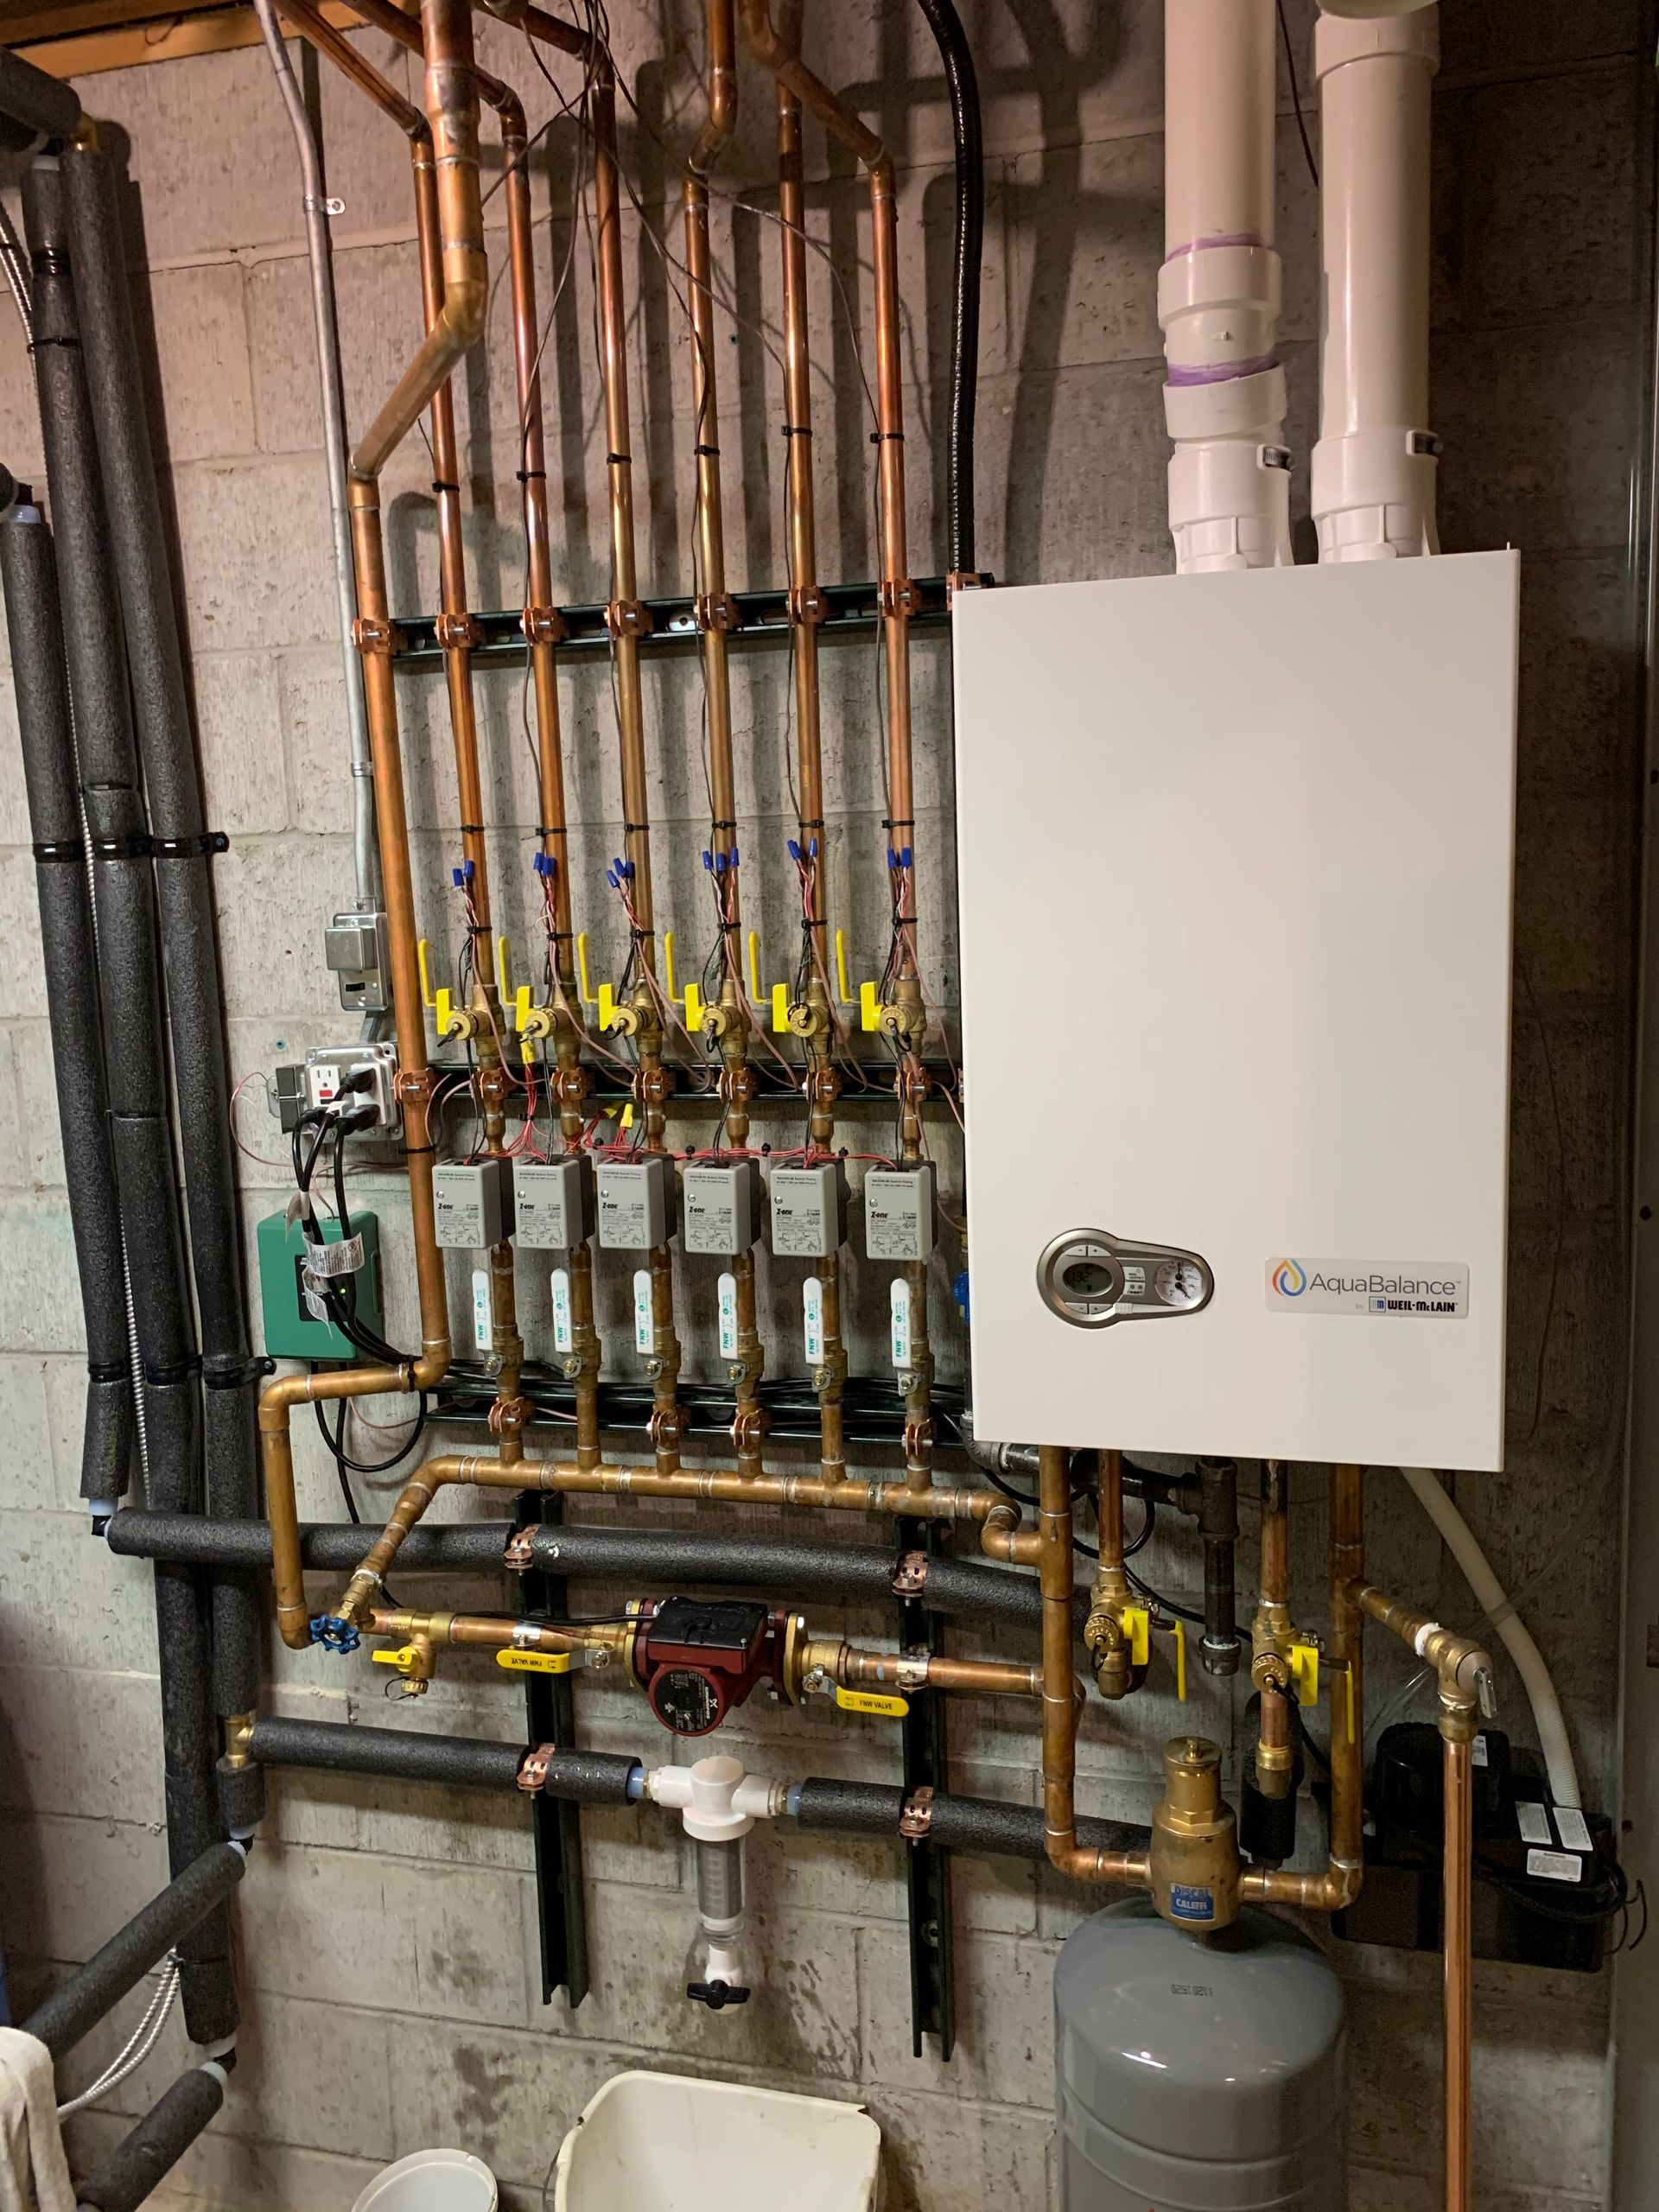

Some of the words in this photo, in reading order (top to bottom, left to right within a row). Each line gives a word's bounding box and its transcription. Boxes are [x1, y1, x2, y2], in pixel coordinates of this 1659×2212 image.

[689, 1205, 706, 1214] Z-one
[1309, 1273, 1456, 1296] AquaBalance
[510, 1656, 529, 1666] VALVE
[529, 1658, 543, 1667] FNW
[874, 1701, 893, 1711] VALVE
[1175, 1897, 1208, 1910] CALEFFI
